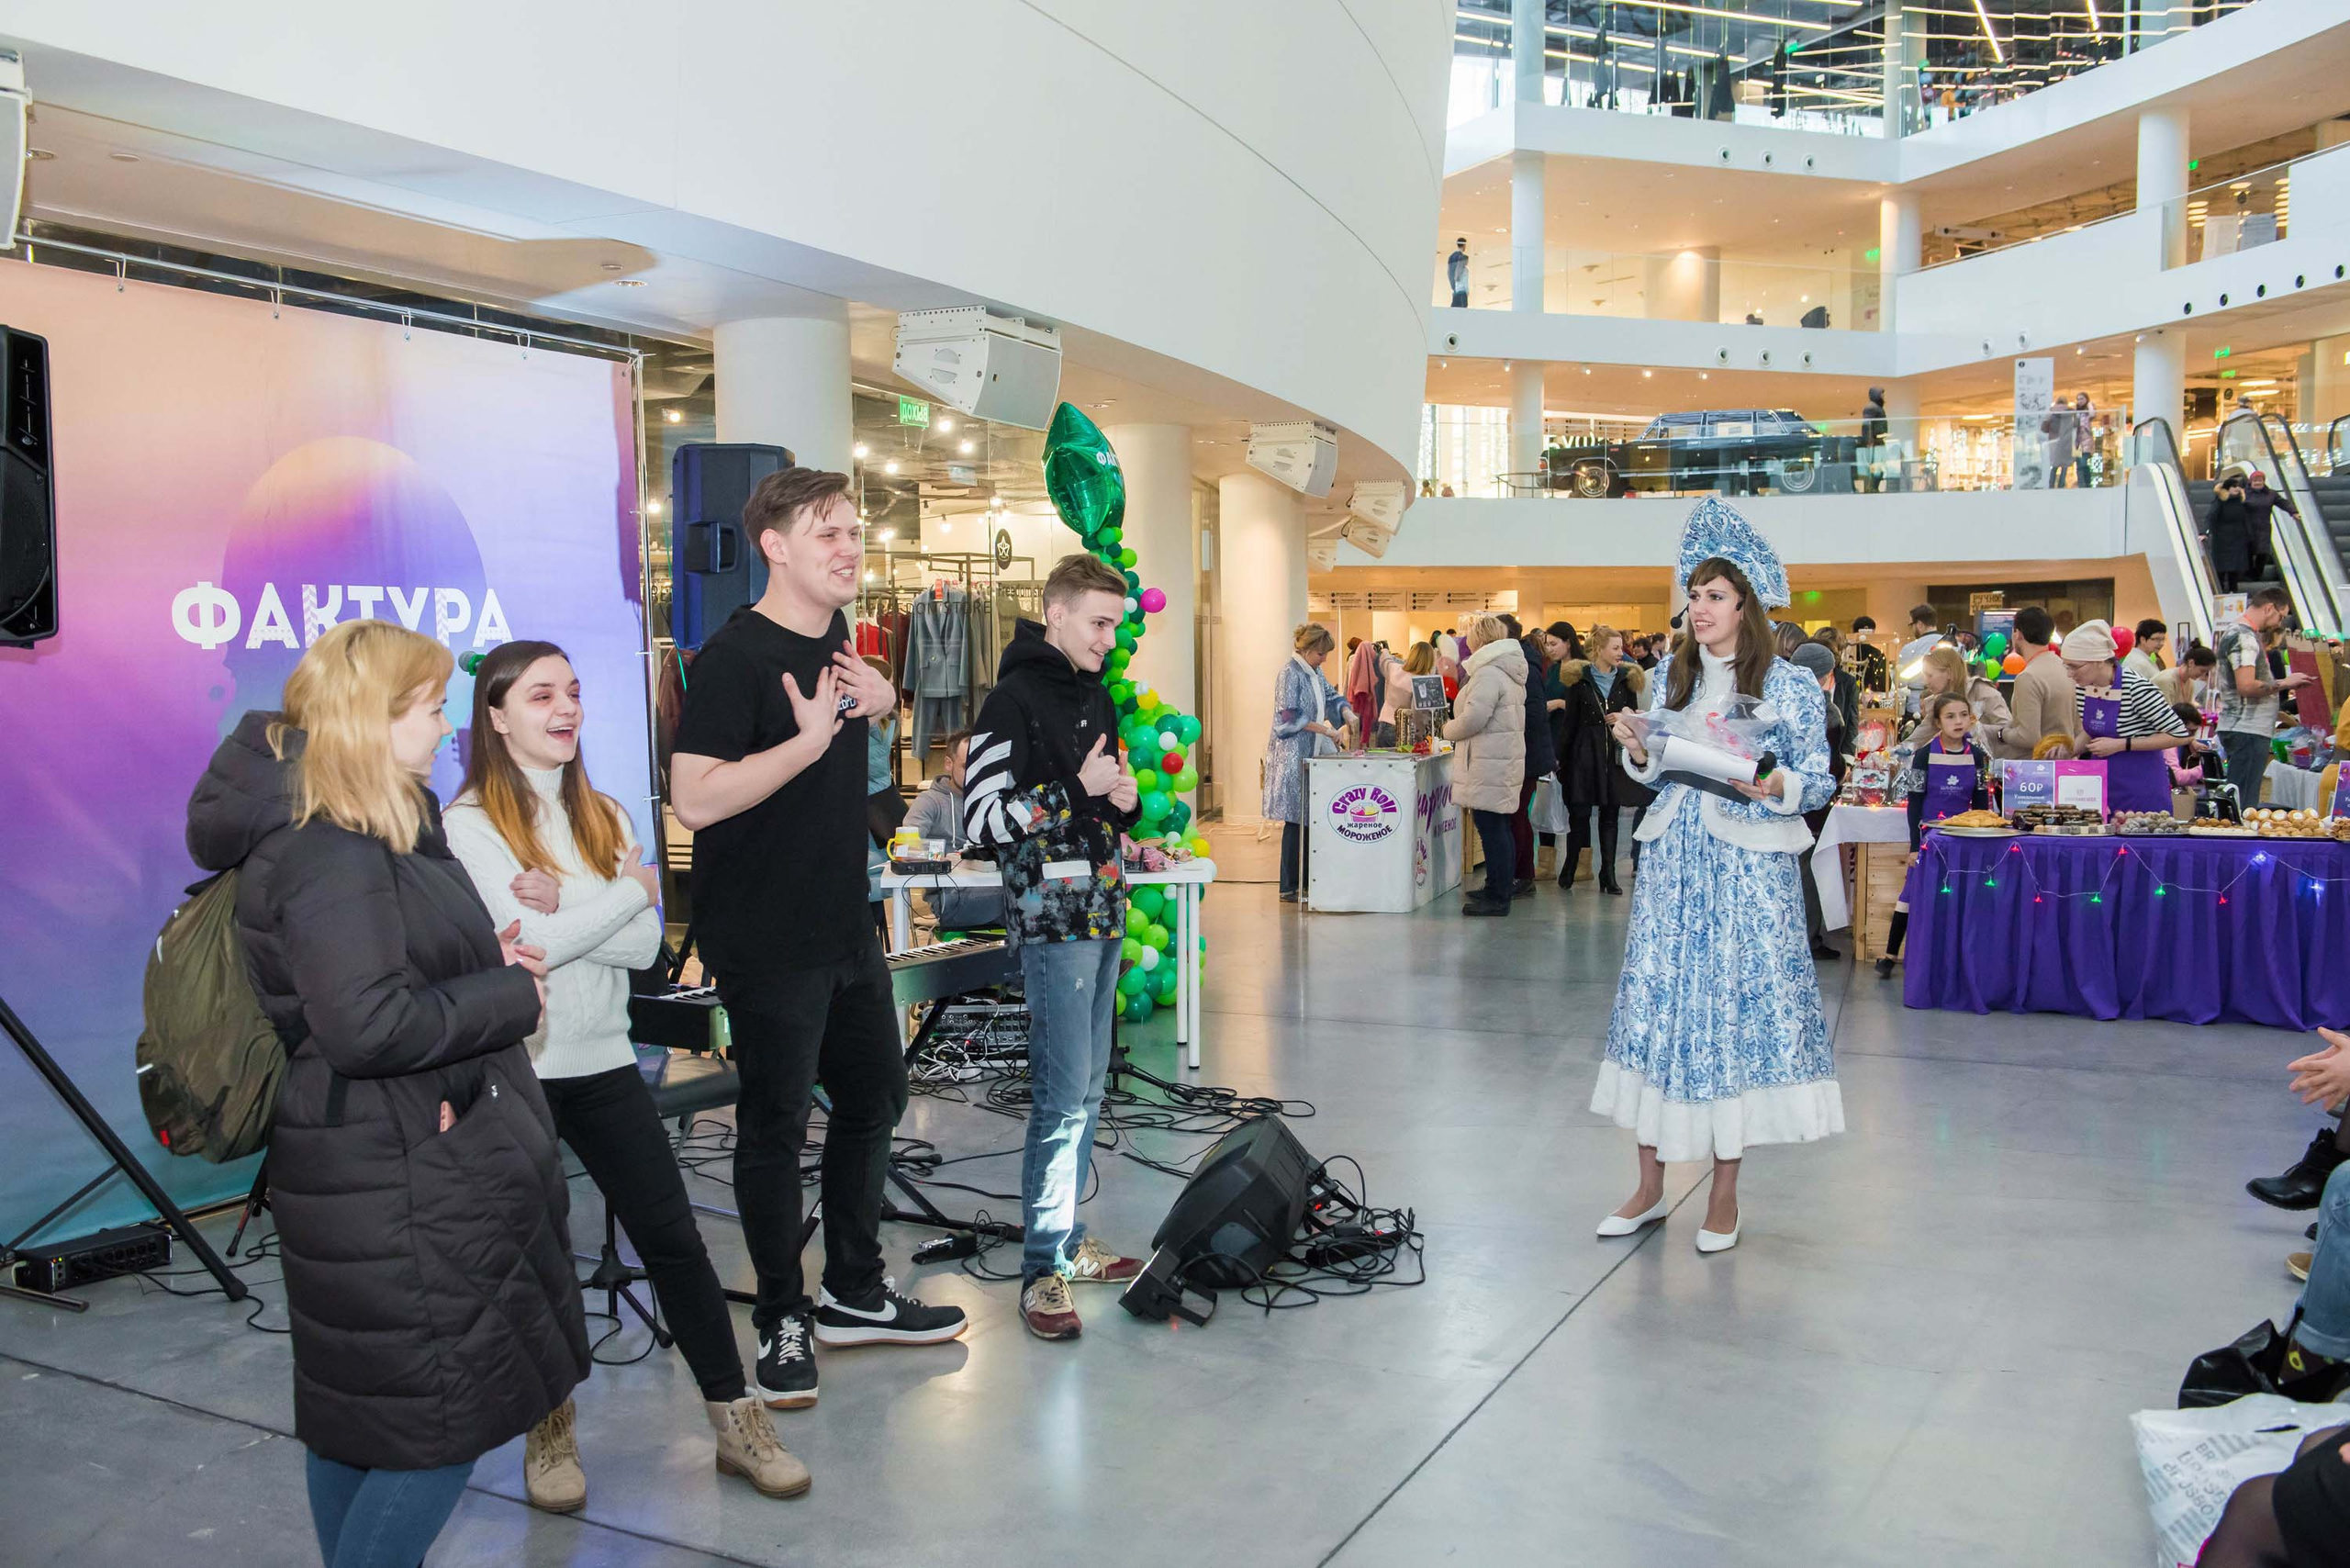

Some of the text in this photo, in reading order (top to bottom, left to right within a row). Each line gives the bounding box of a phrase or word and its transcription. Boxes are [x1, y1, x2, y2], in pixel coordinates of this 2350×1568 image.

[171, 581, 514, 650] ФАКТУРА
[944, 600, 992, 615] STORE
[1332, 787, 1397, 814] Crazy Roll
[1337, 824, 1393, 841] МОРОЖЕНОЕ
